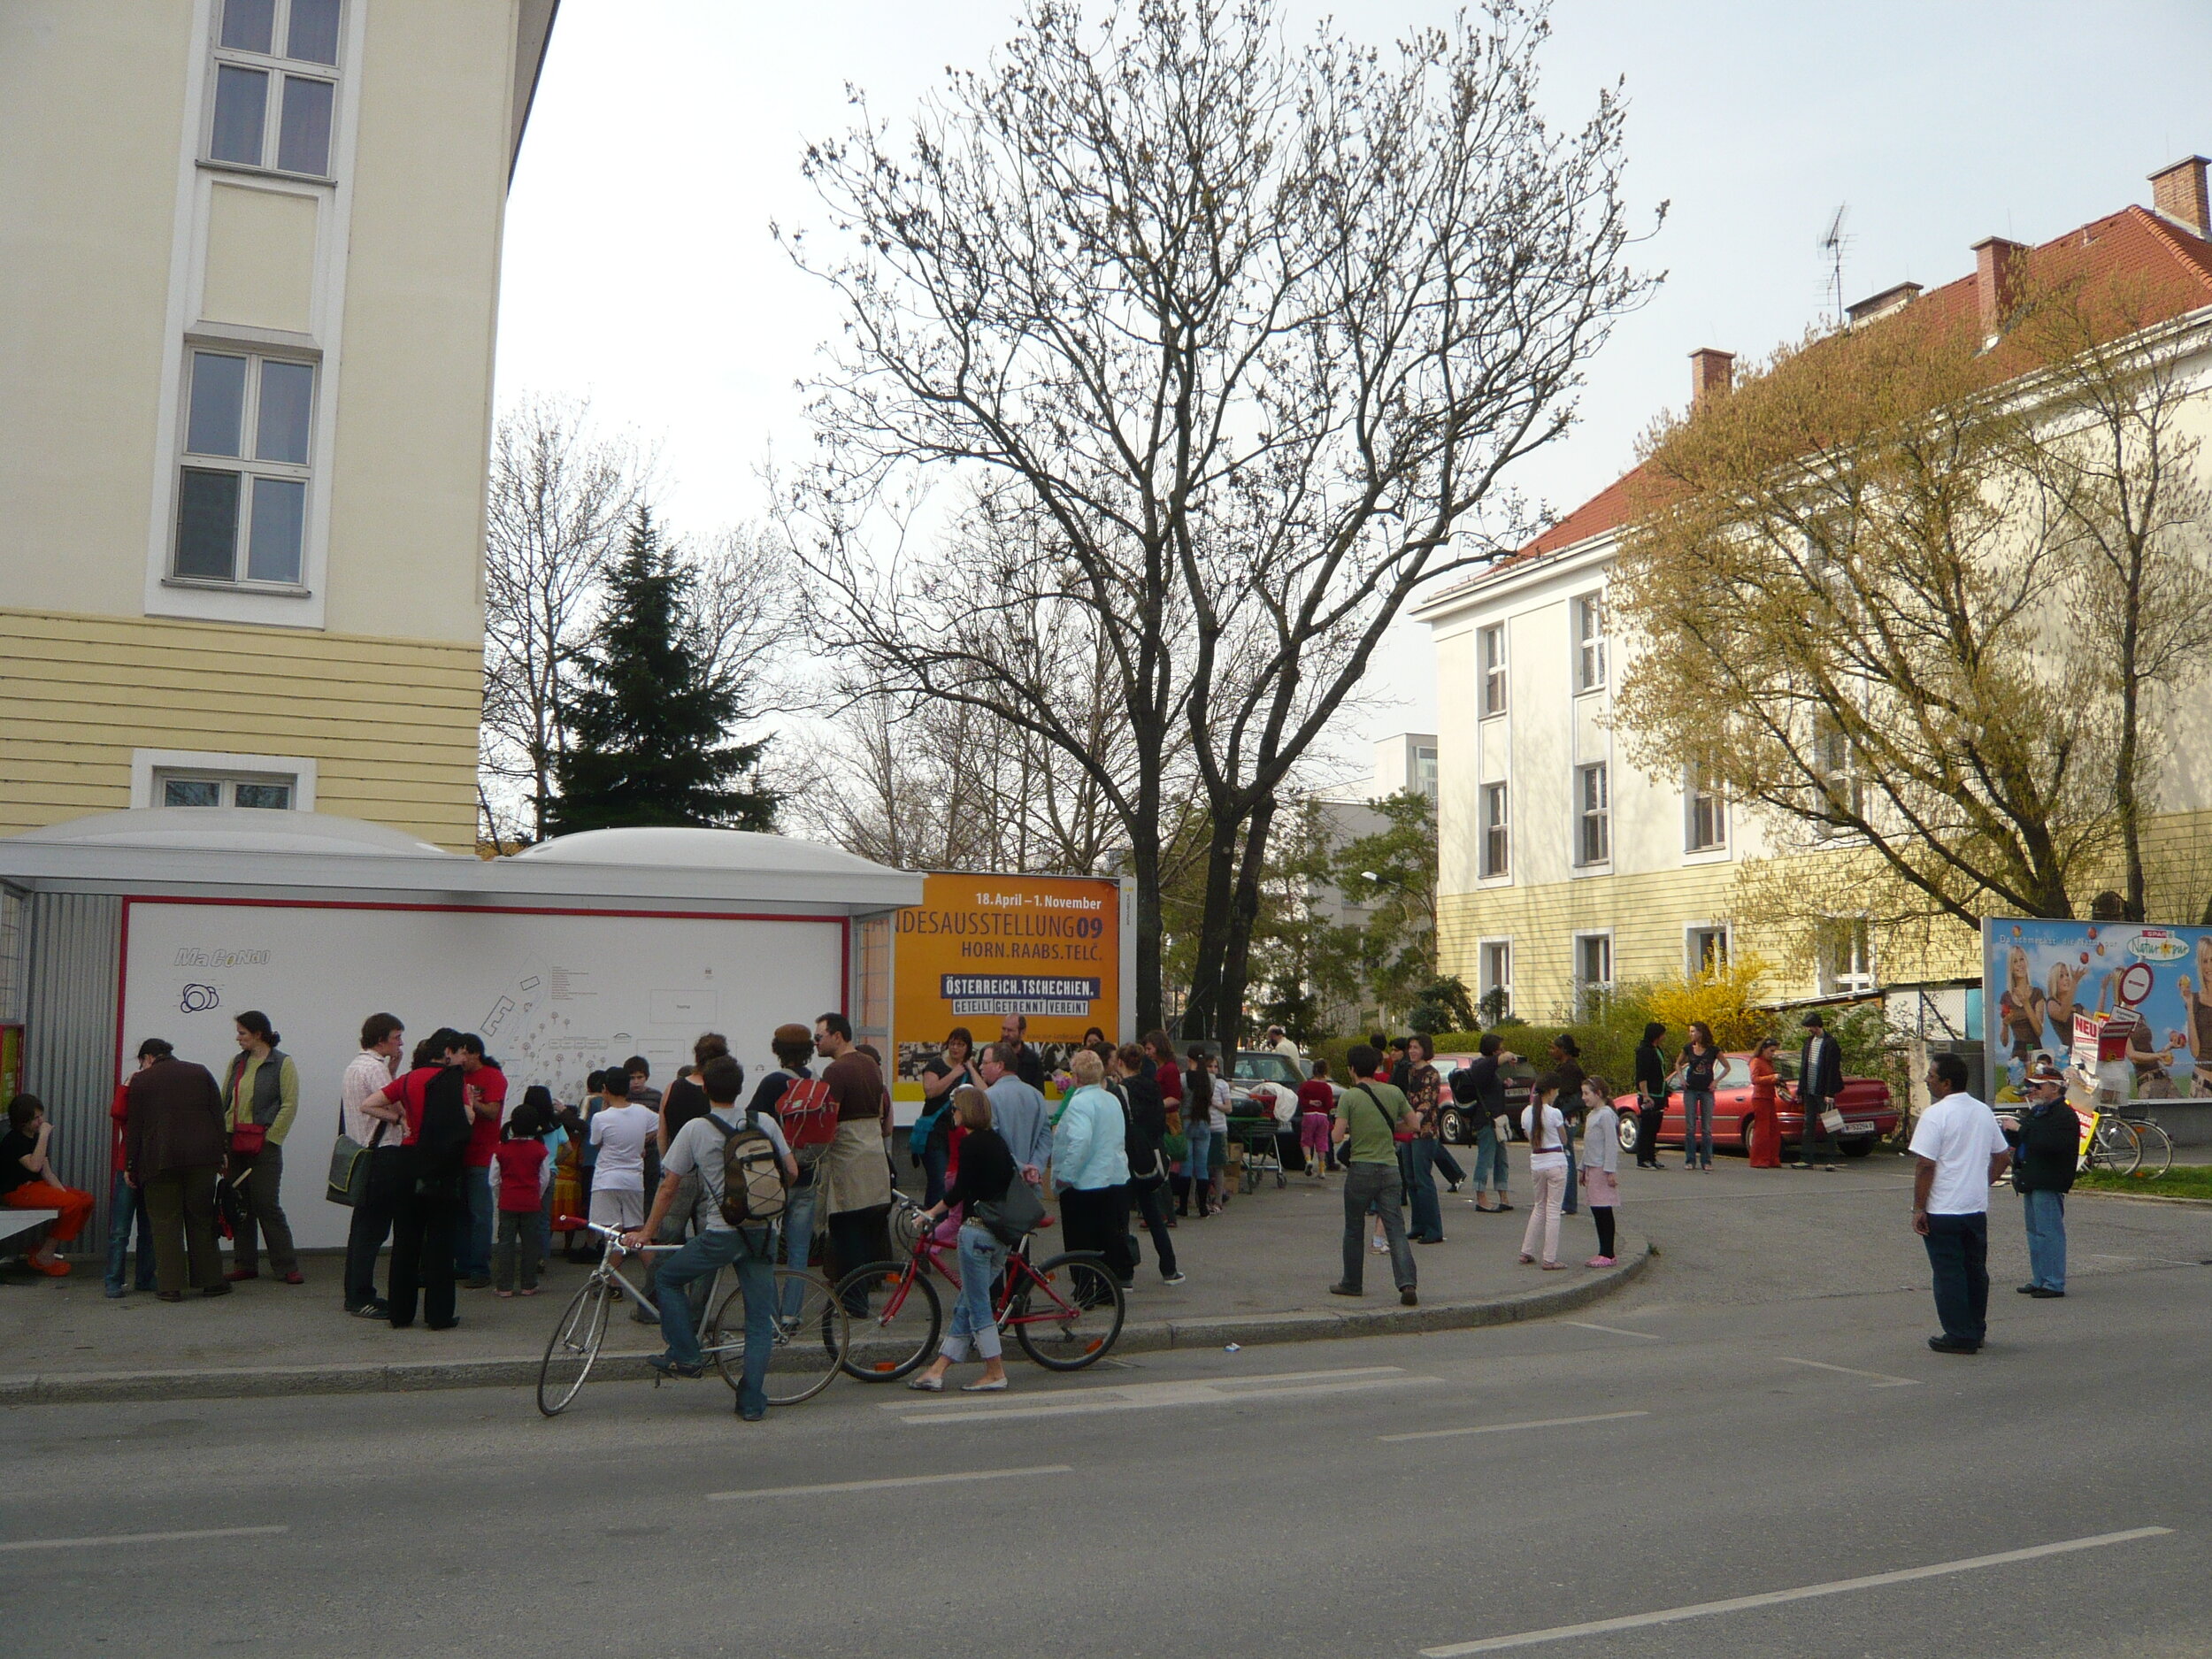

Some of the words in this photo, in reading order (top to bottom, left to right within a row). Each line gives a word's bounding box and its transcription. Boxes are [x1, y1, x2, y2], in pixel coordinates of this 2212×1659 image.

[995, 892, 1022, 909] April
[1033, 894, 1042, 907] 1.
[1045, 895, 1102, 910] November
[995, 1001, 1043, 1014] GETRENNT
[2075, 1016, 2098, 1038] NEU
